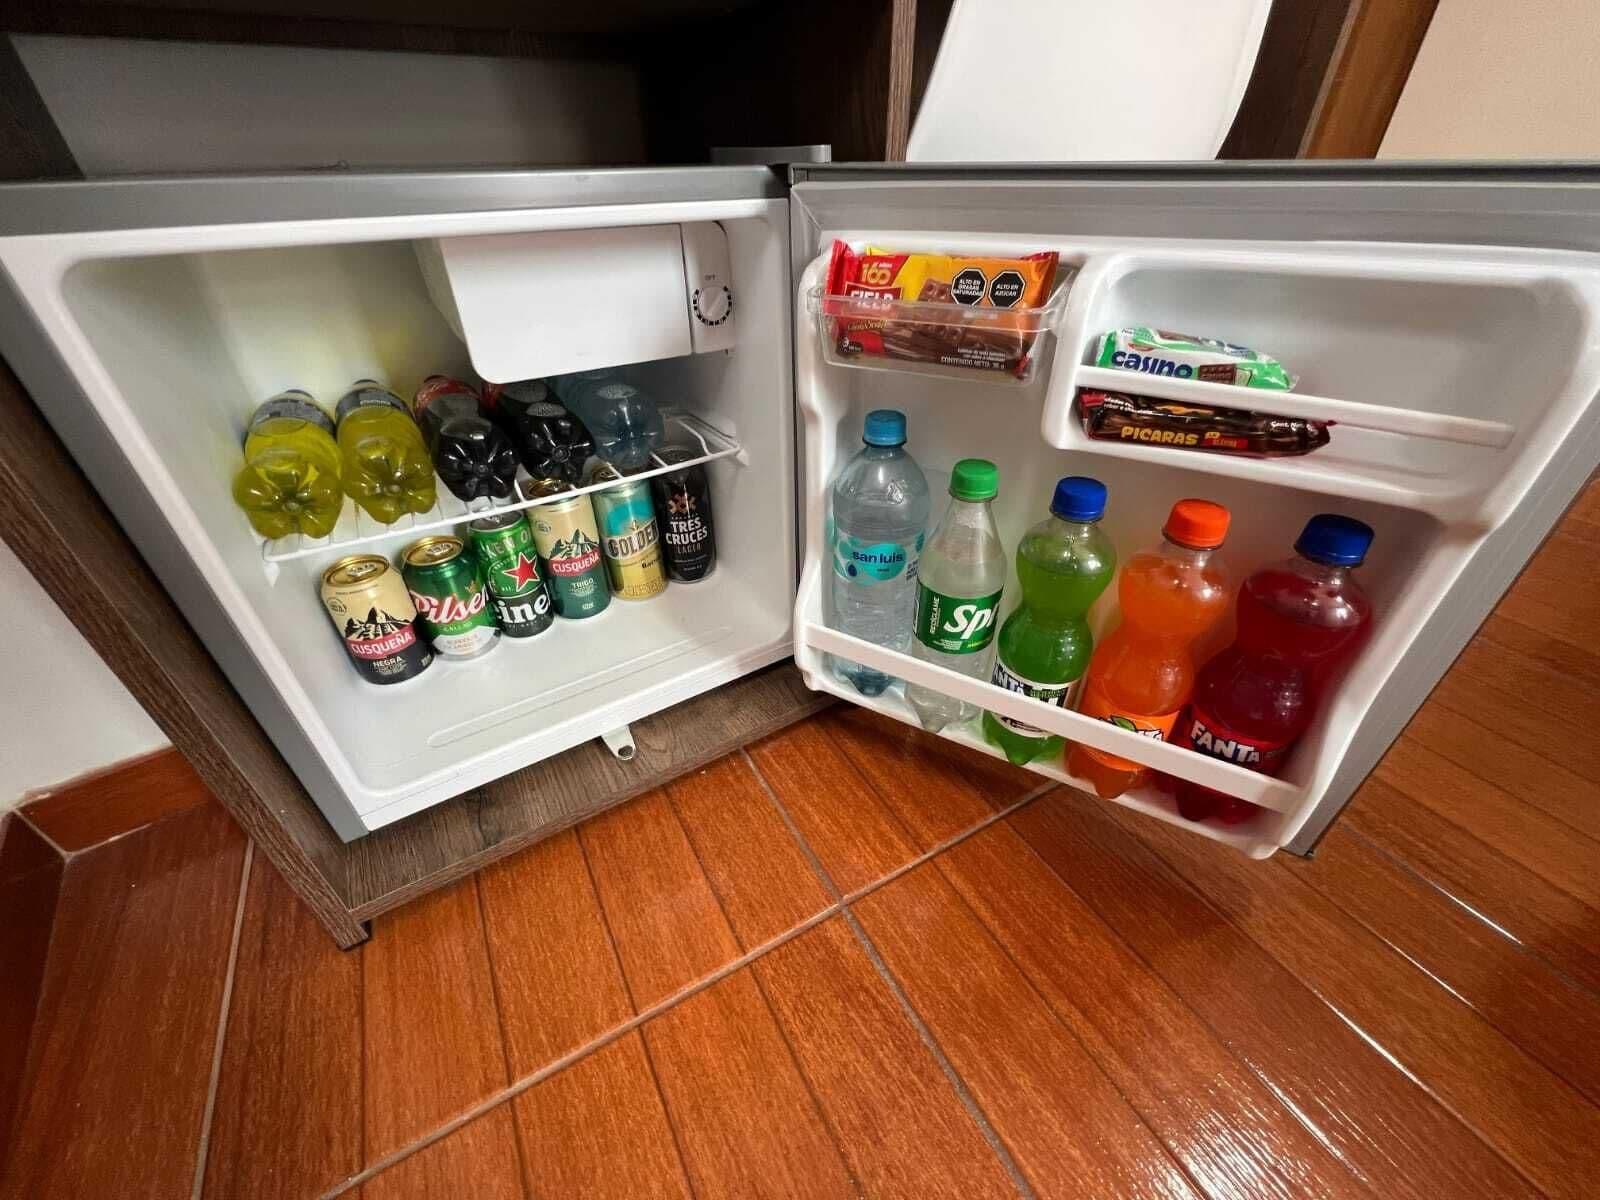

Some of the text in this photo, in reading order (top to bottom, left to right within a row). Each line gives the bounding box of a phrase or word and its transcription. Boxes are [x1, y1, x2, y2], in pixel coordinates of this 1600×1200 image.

[1111, 350, 1193, 380] casino
[1120, 425, 1199, 446] PICARAS
[670, 516, 702, 533] TRES
[665, 526, 708, 545] CRUCES
[551, 551, 600, 573] CUSQUEÑA
[852, 551, 904, 564] san luis
[494, 584, 551, 624] ine
[350, 631, 413, 656] CUSQUEÑA
[372, 656, 403, 668] NEGRA
[1190, 719, 1260, 763] FANTA
